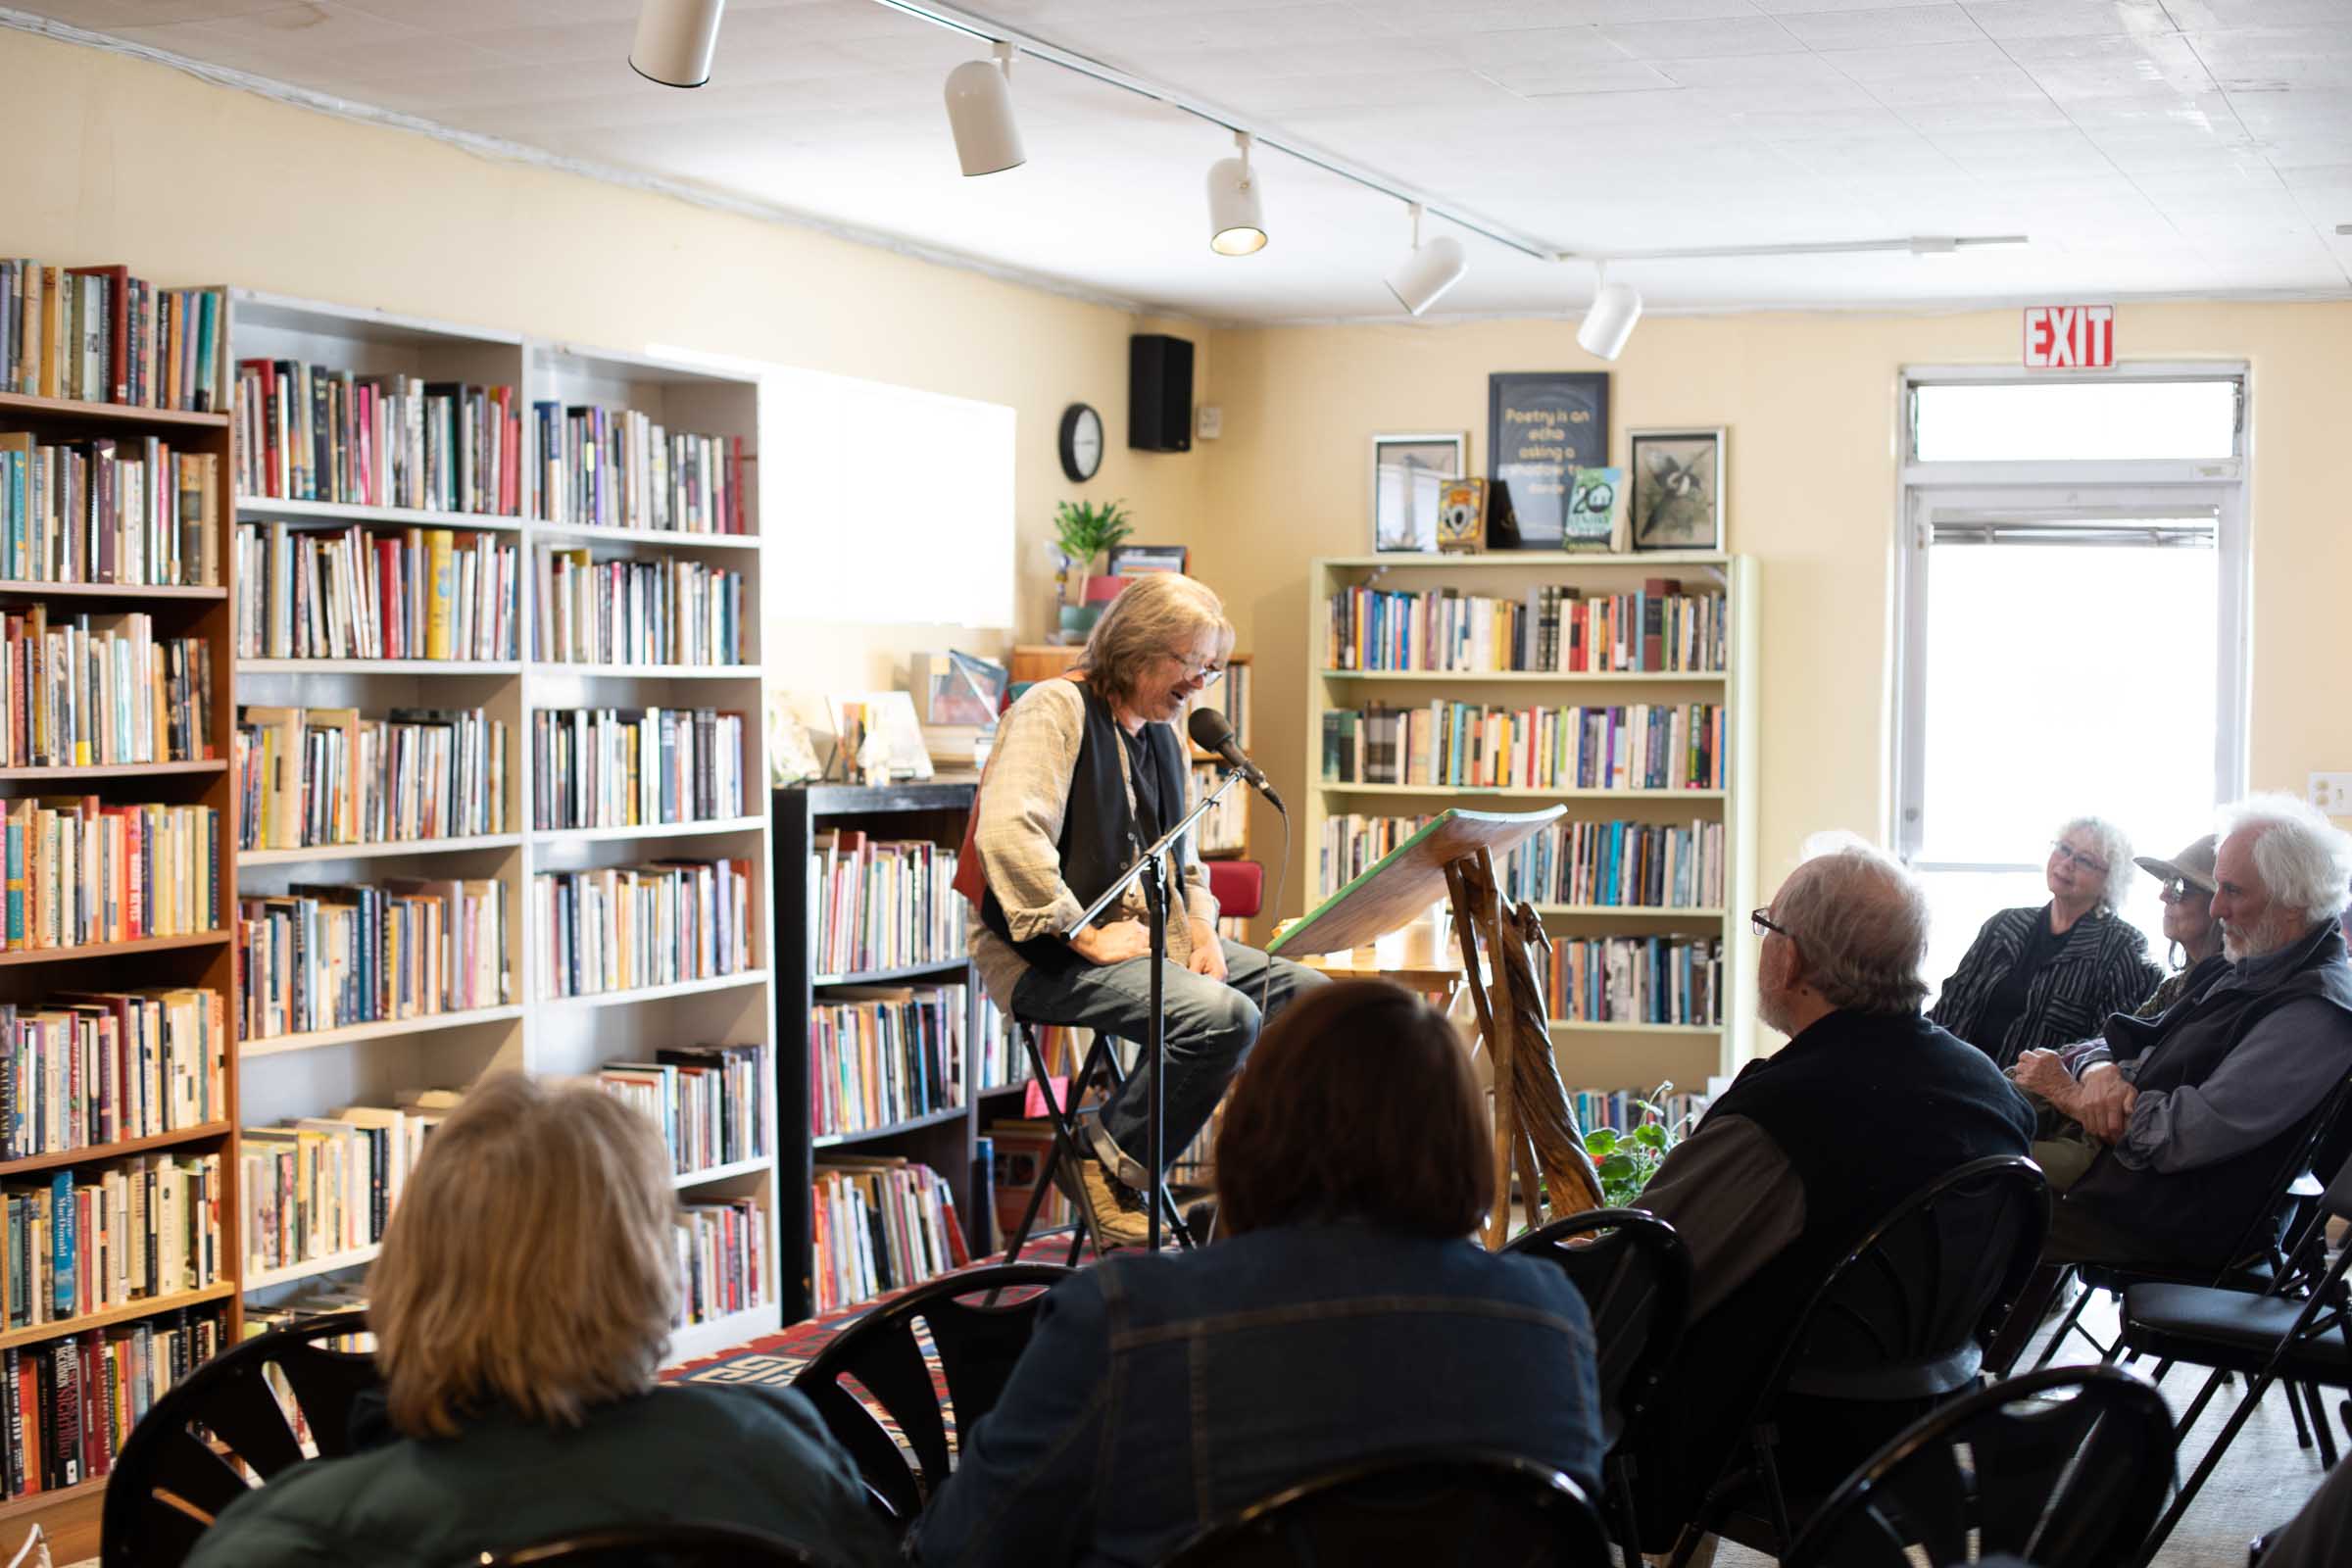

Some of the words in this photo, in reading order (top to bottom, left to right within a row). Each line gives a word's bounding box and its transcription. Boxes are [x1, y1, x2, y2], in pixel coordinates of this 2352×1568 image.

[2026, 306, 2112, 367] EXIT
[1504, 408, 1555, 425] Poetry
[1556, 409, 1568, 422] is
[1570, 412, 1590, 423] an
[1528, 427, 1565, 442] echo
[1519, 445, 1563, 463] asking
[1565, 448, 1576, 460] a
[57, 1198, 67, 1256] MacDonald
